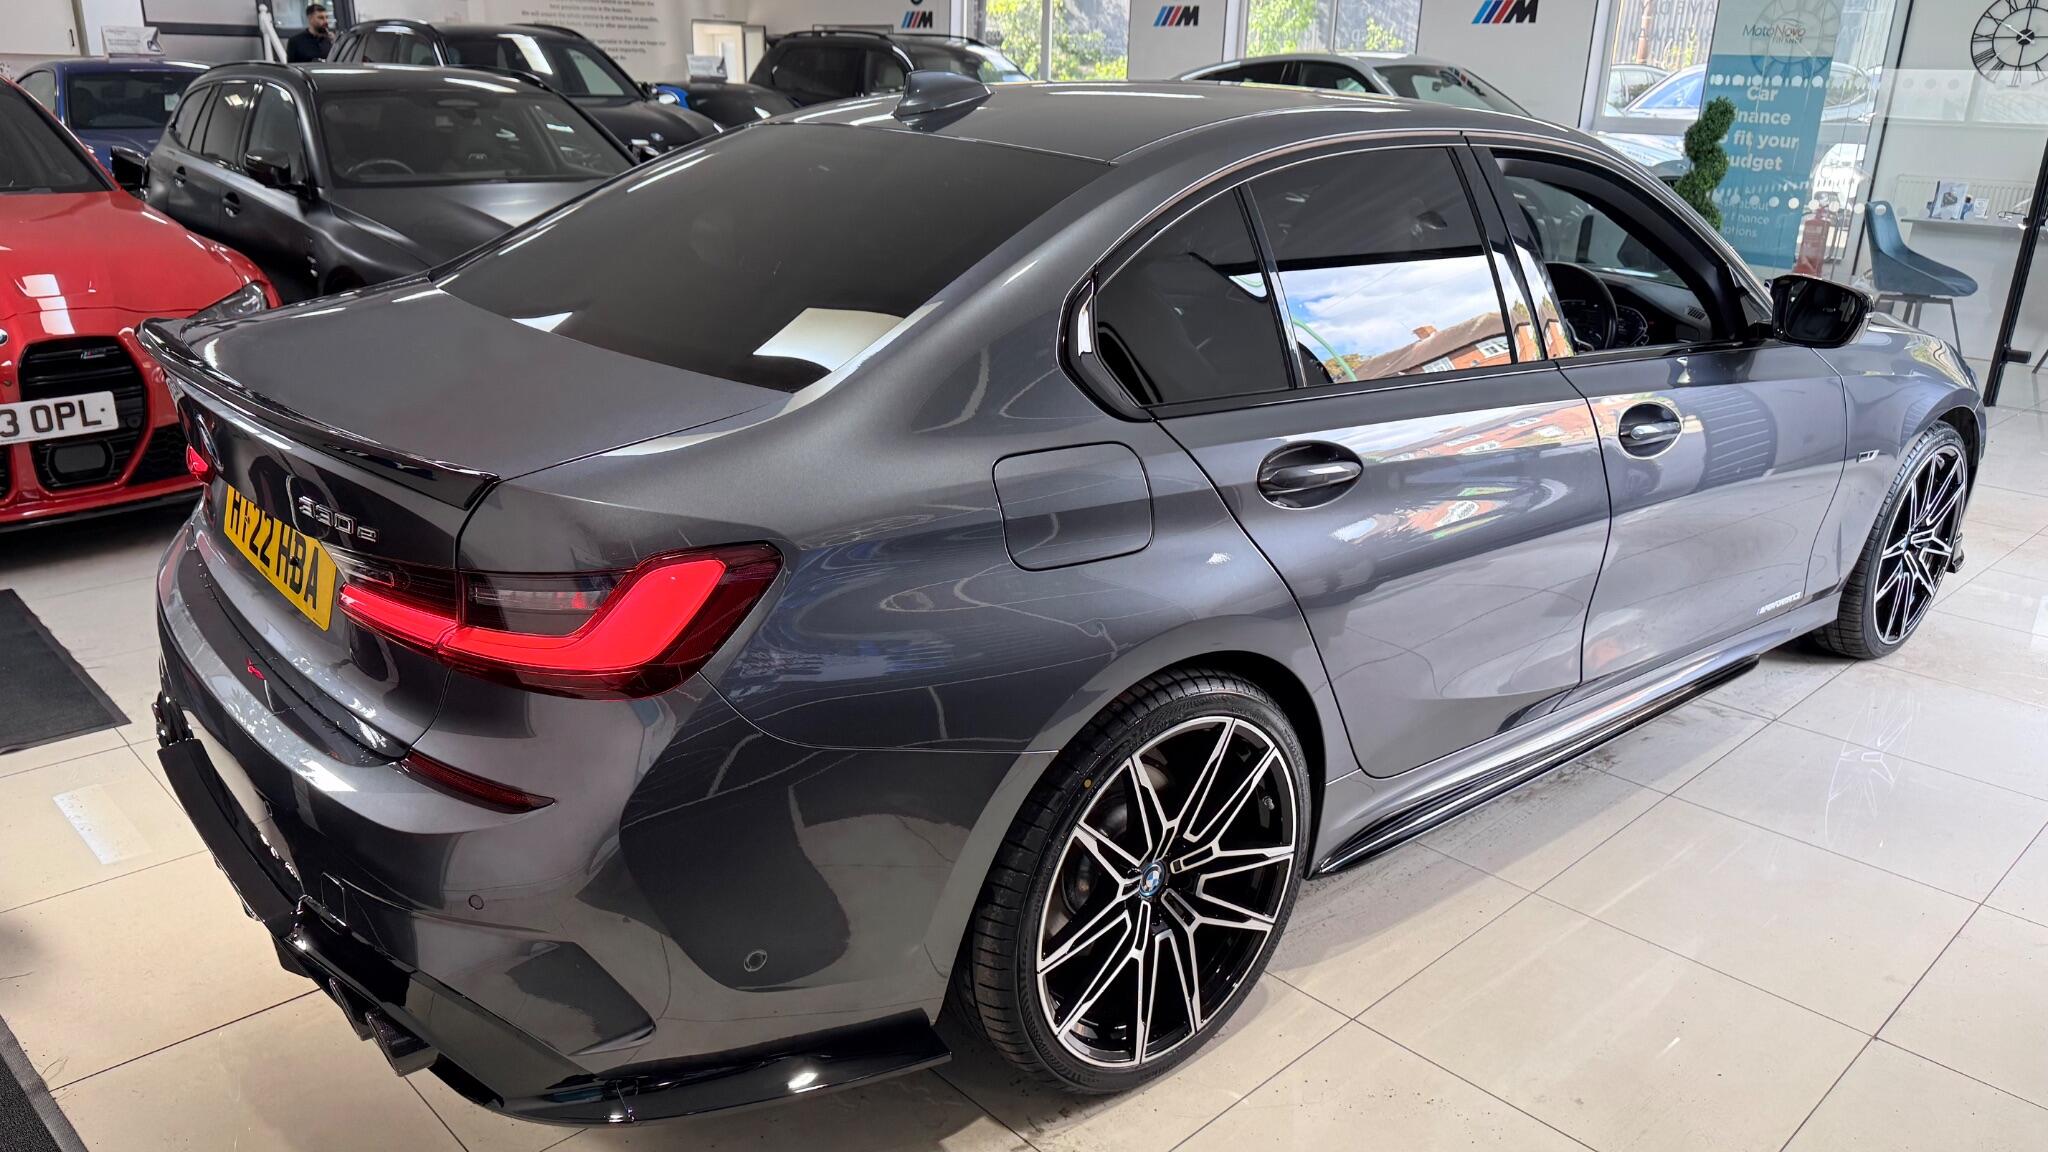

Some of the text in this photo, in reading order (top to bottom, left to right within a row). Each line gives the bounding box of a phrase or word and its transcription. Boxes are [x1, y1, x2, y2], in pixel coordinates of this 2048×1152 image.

[1747, 87, 1779, 101] Car
[1734, 107, 1792, 125] nance
[1733, 129, 1754, 146] fit
[1757, 134, 1800, 149] your
[1727, 153, 1783, 172] udget
[29, 400, 102, 433] OPL
[276, 523, 319, 611] HBA
